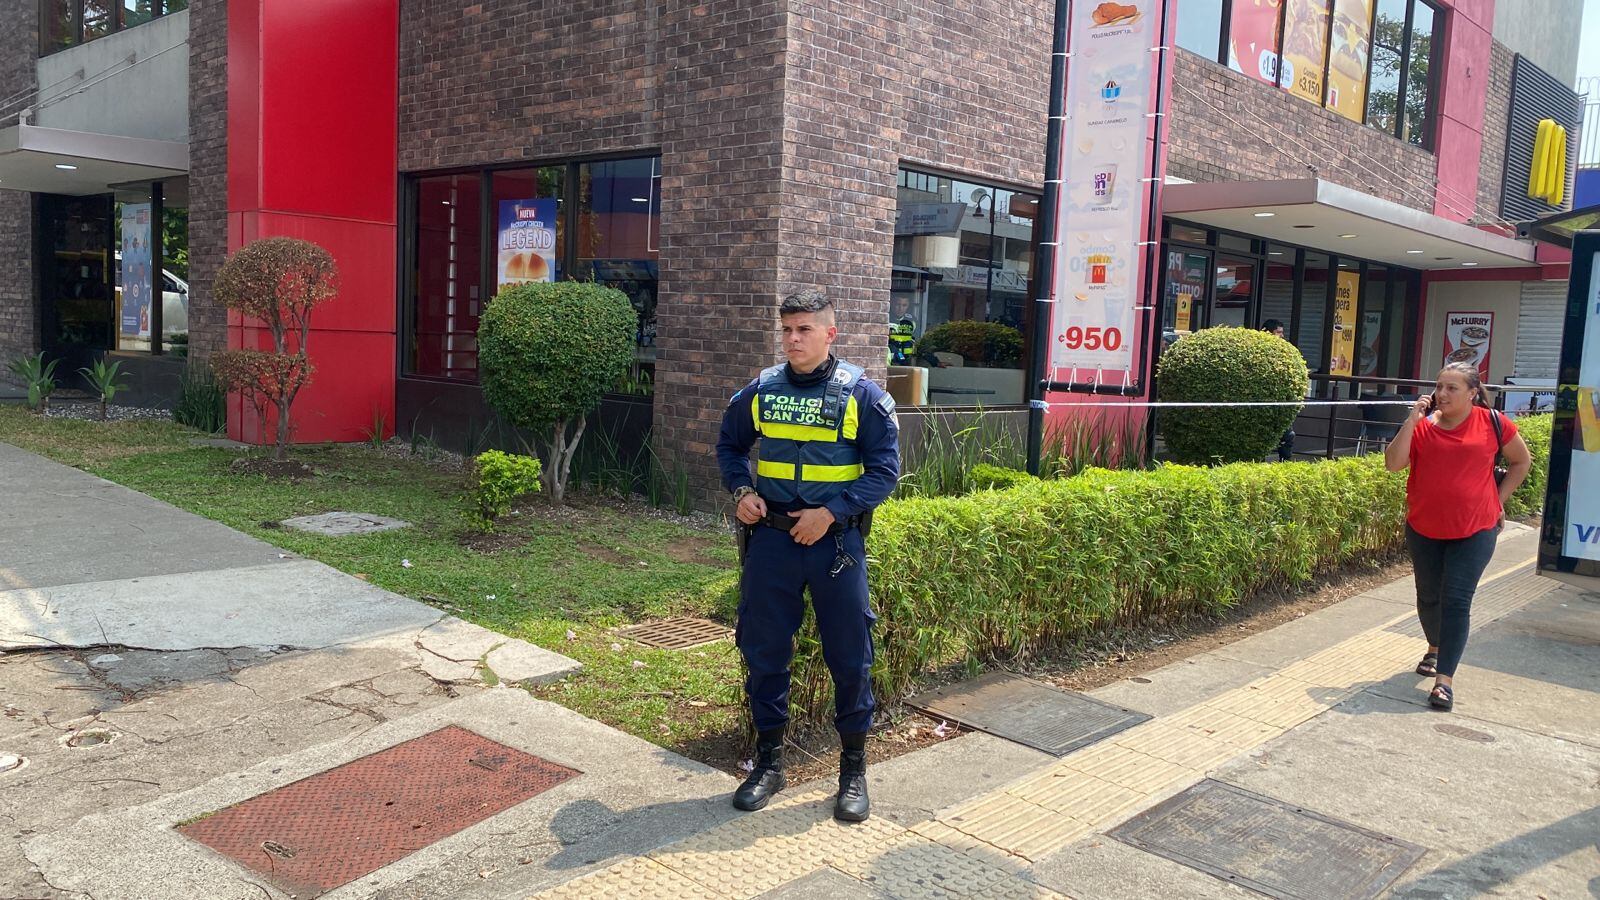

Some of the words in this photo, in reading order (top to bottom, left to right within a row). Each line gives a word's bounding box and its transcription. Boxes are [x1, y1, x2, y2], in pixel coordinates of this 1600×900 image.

[519, 209, 535, 219] NUEVA
[502, 228, 553, 250] LEGEND
[1450, 317, 1490, 326] McFLURRY
[772, 404, 821, 414] MUNICIPA
[763, 410, 793, 421] SAN
